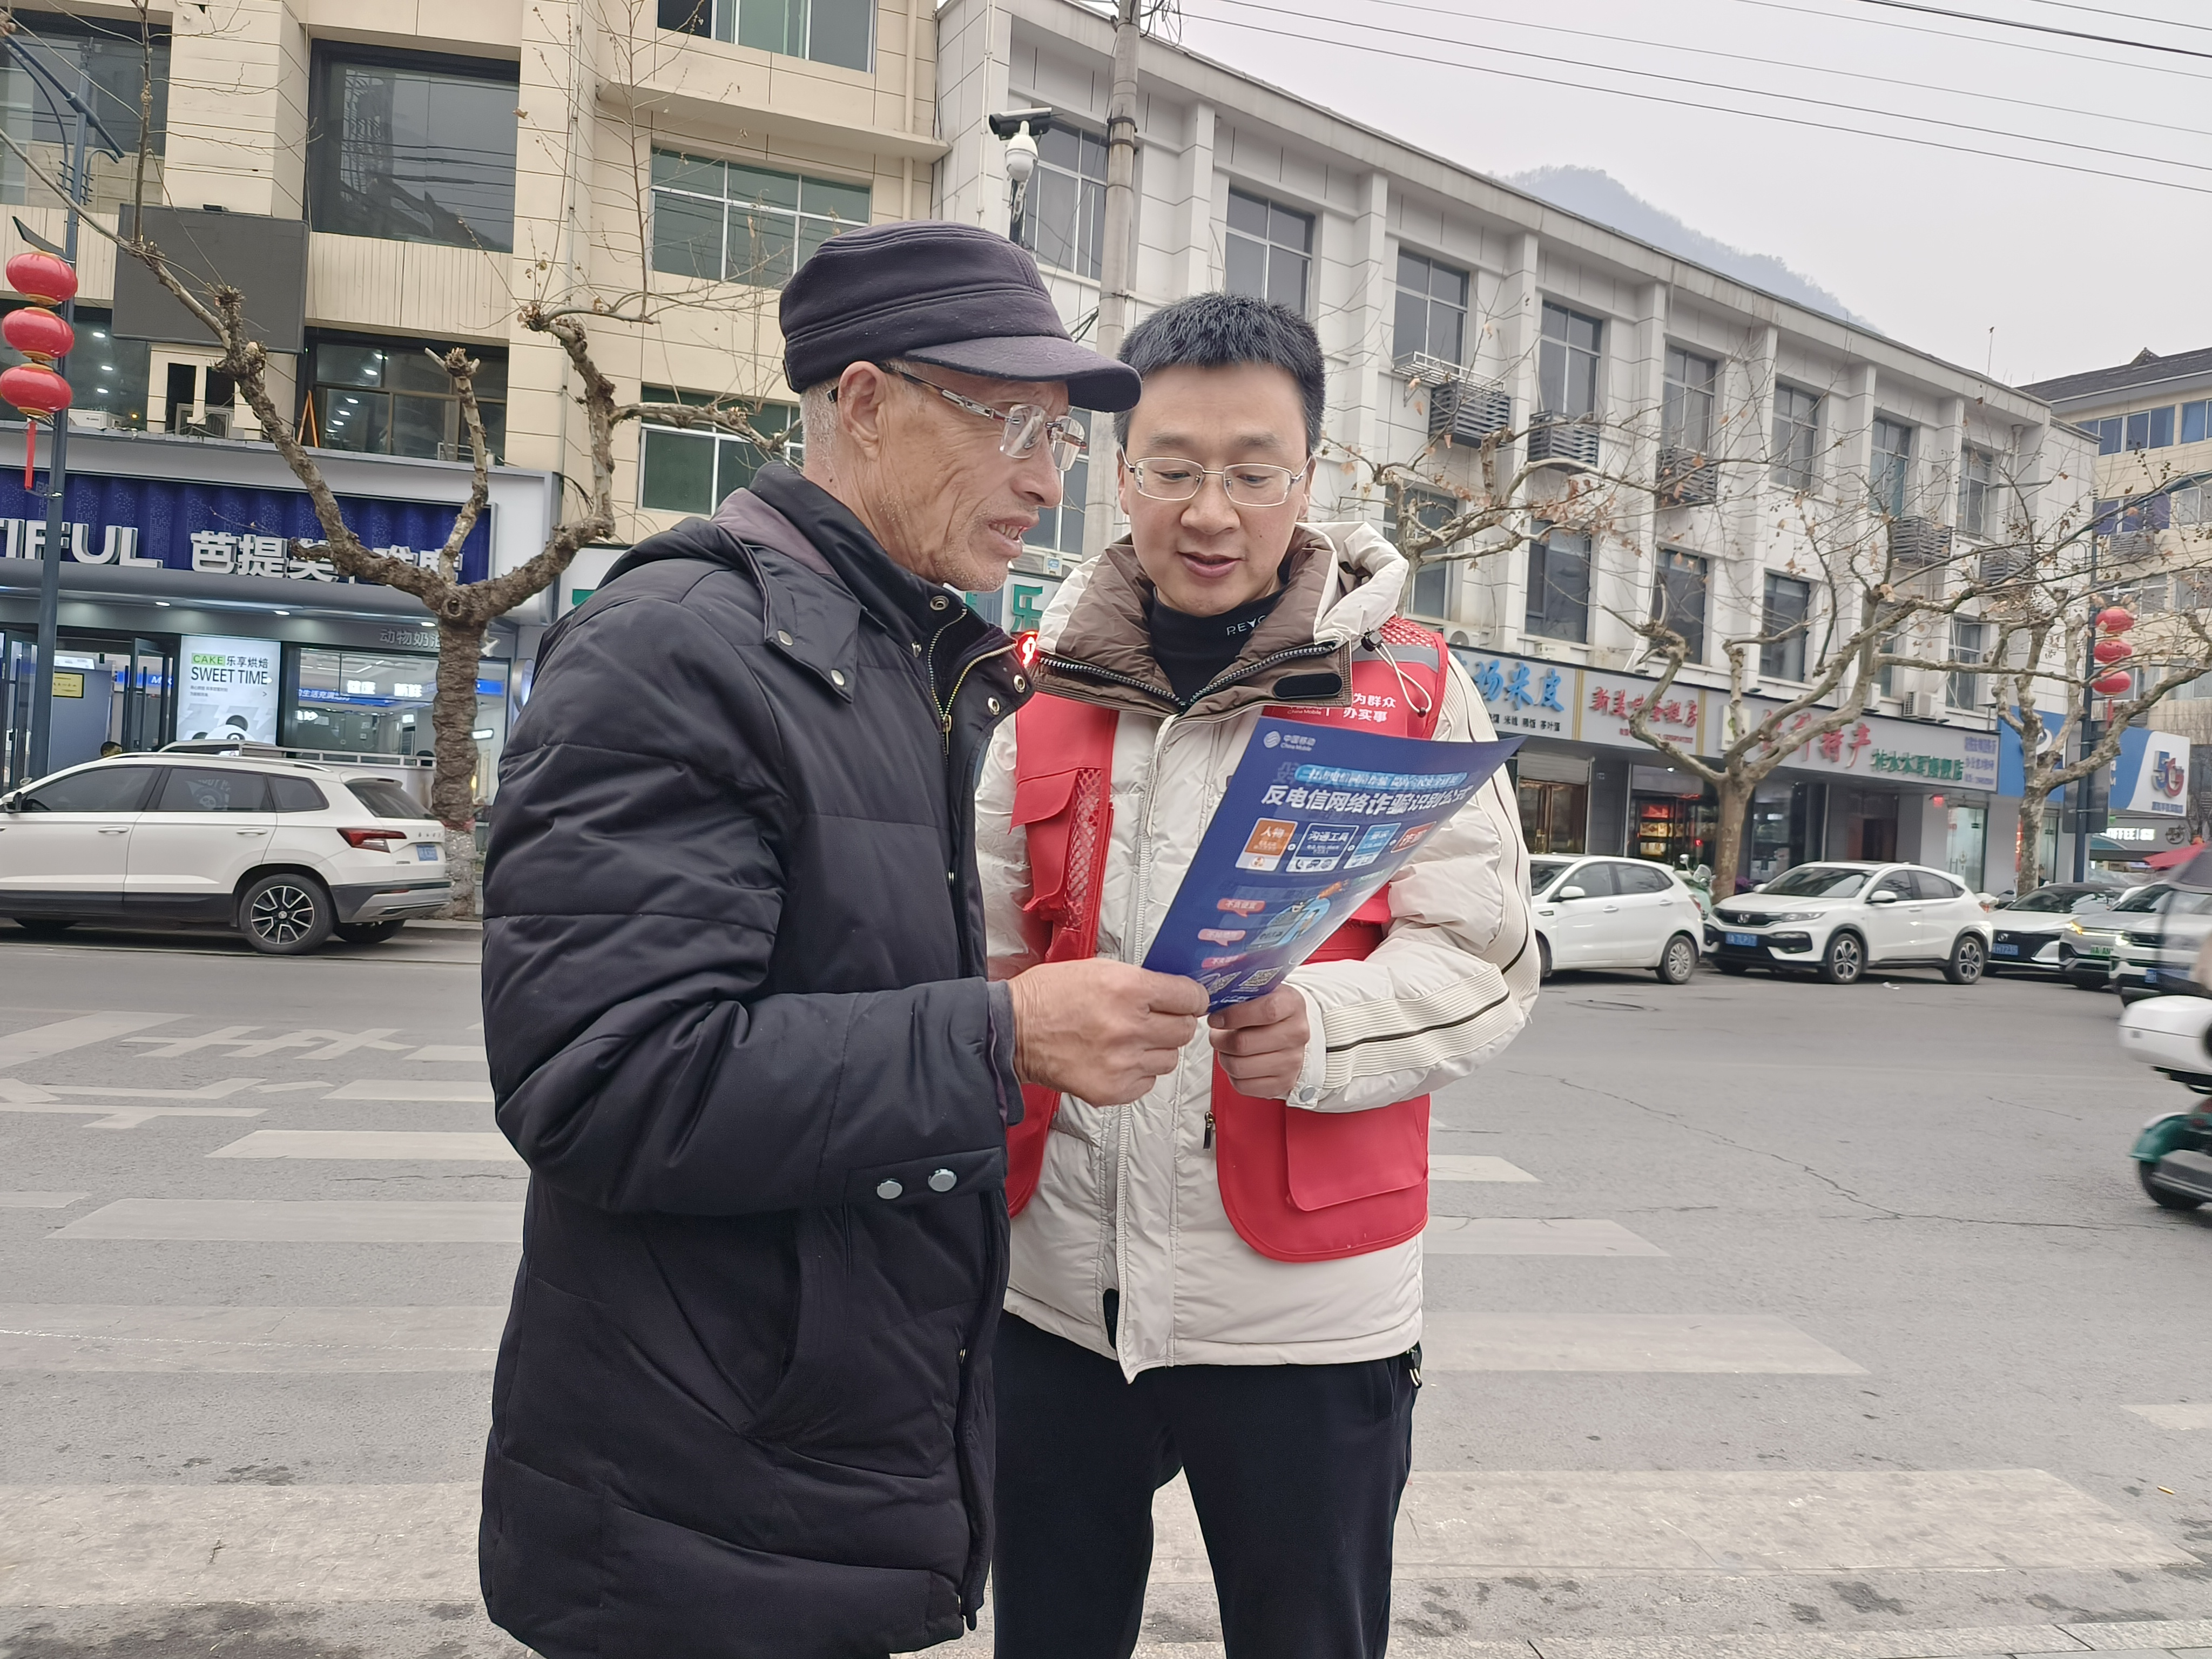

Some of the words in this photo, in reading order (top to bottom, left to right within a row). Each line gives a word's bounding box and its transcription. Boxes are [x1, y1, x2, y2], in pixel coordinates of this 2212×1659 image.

[0, 517, 163, 569] IFUL
[193, 655, 223, 665] CAKE
[226, 656, 268, 669] 乐享烘焙
[191, 666, 235, 683] SWEET
[238, 670, 268, 685] TIME
[1353, 693, 1396, 708] 为群众
[1343, 707, 1388, 723] 办实事
[2152, 751, 2184, 798] 5G
[1261, 785, 1474, 815] 反电信网络诈骗识别公式
[1260, 826, 1285, 839] 人物
[1308, 830, 1349, 842] 沟通工具
